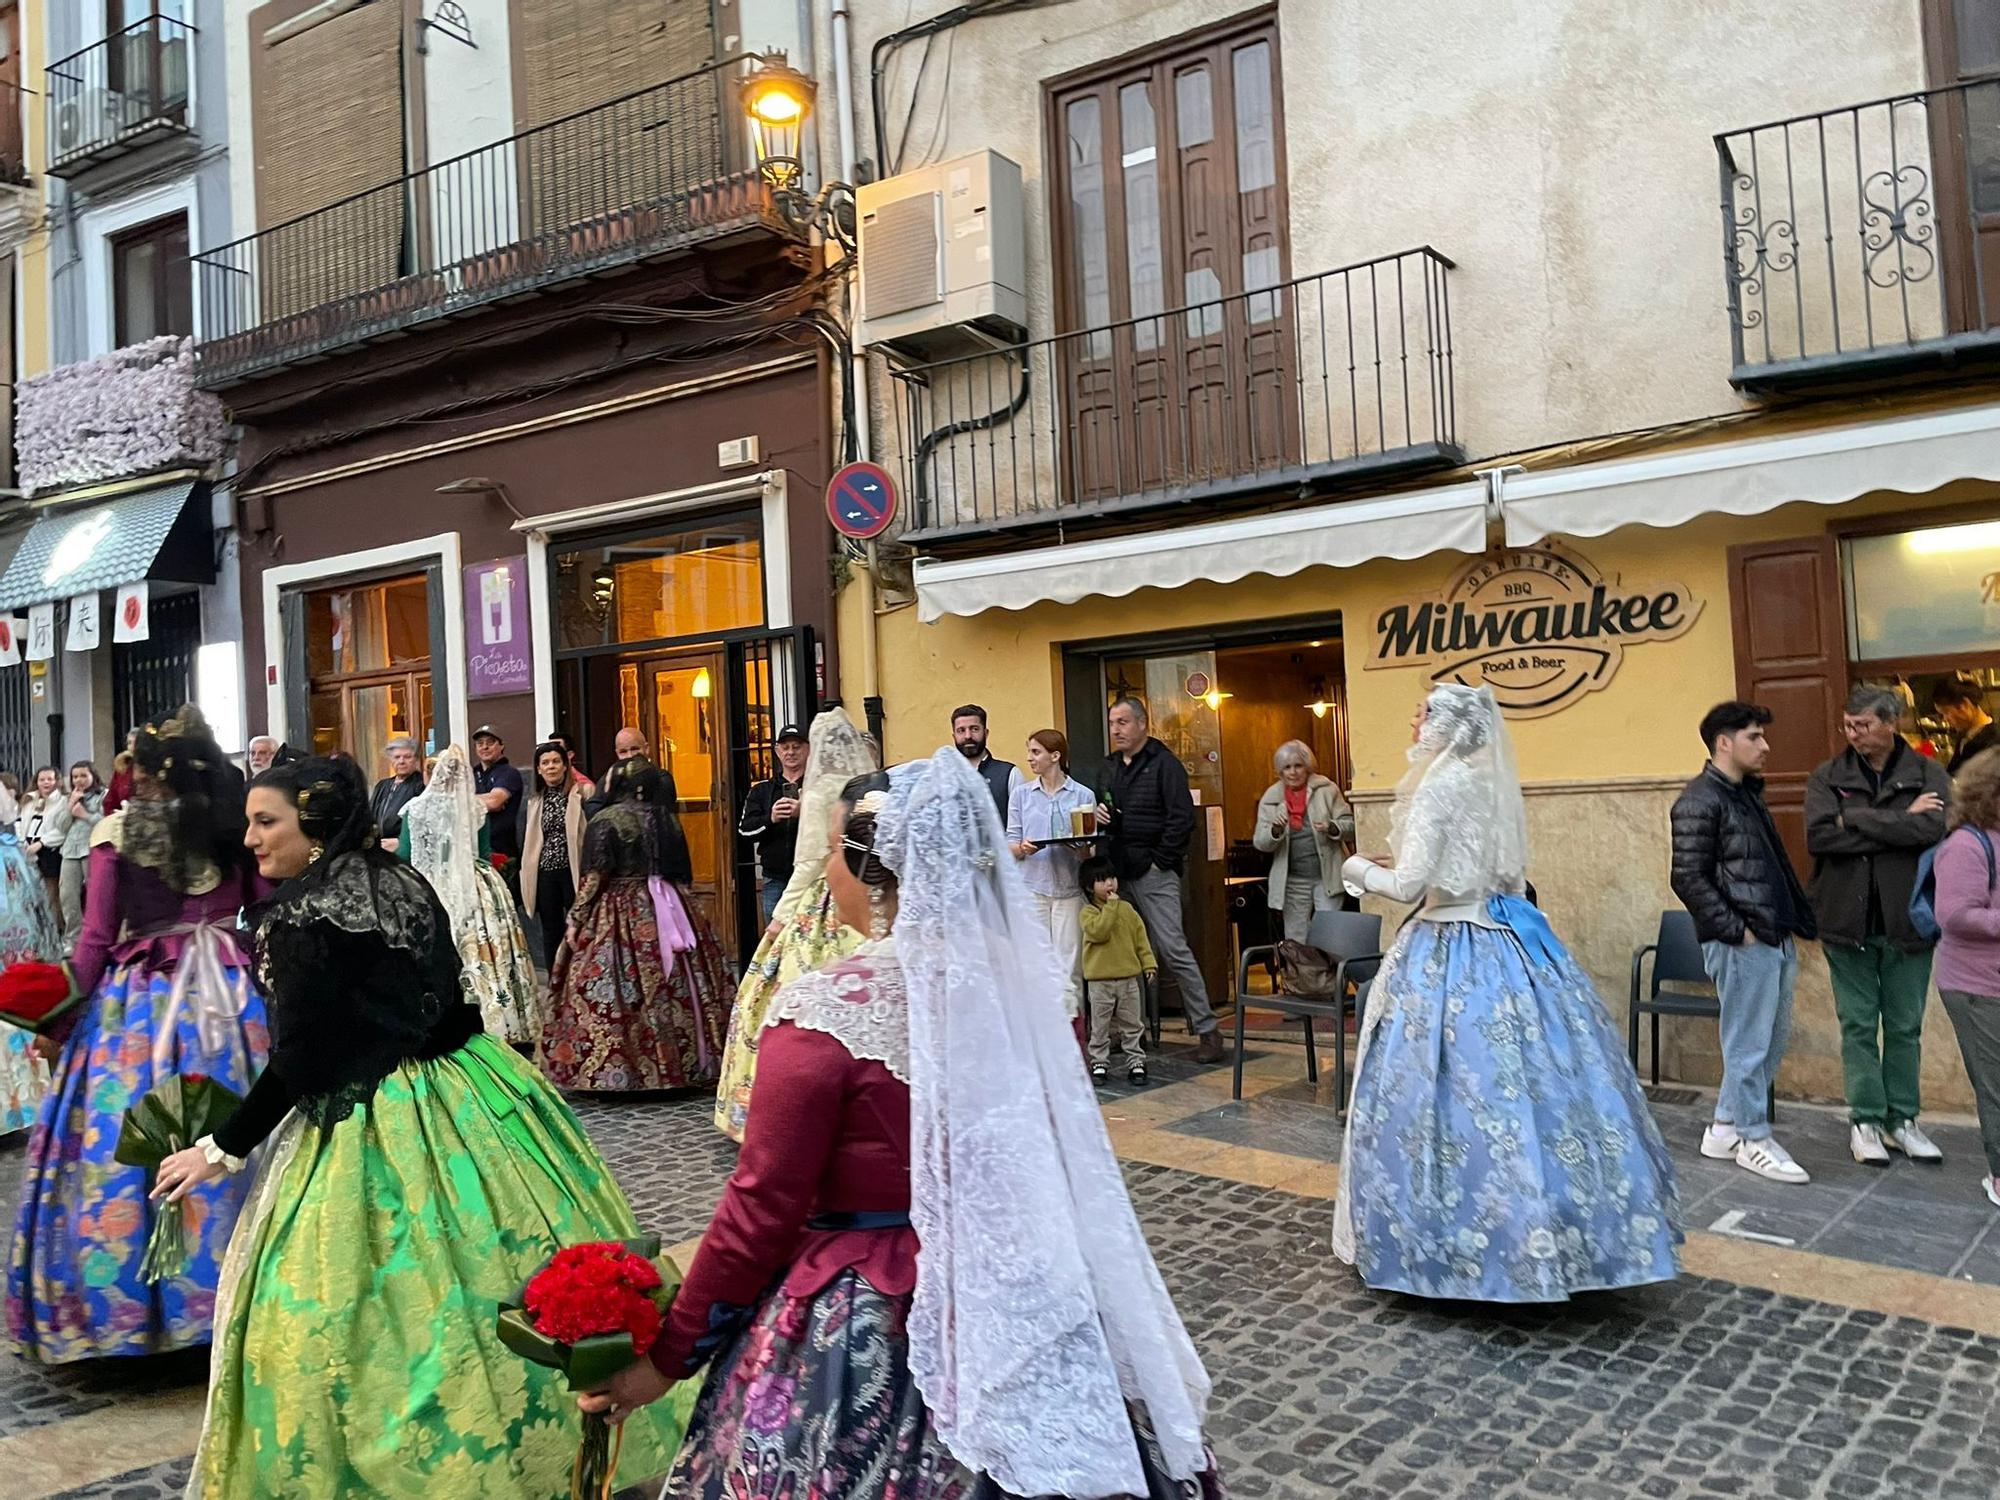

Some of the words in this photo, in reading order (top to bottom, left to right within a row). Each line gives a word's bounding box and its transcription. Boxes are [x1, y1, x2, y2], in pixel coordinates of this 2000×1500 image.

[1503, 581, 1532, 597] BBQ
[1377, 585, 1685, 659] Milwaukee
[1481, 658, 1515, 674] Food
[1518, 657, 1529, 669] &
[1532, 655, 1566, 669] Beer
